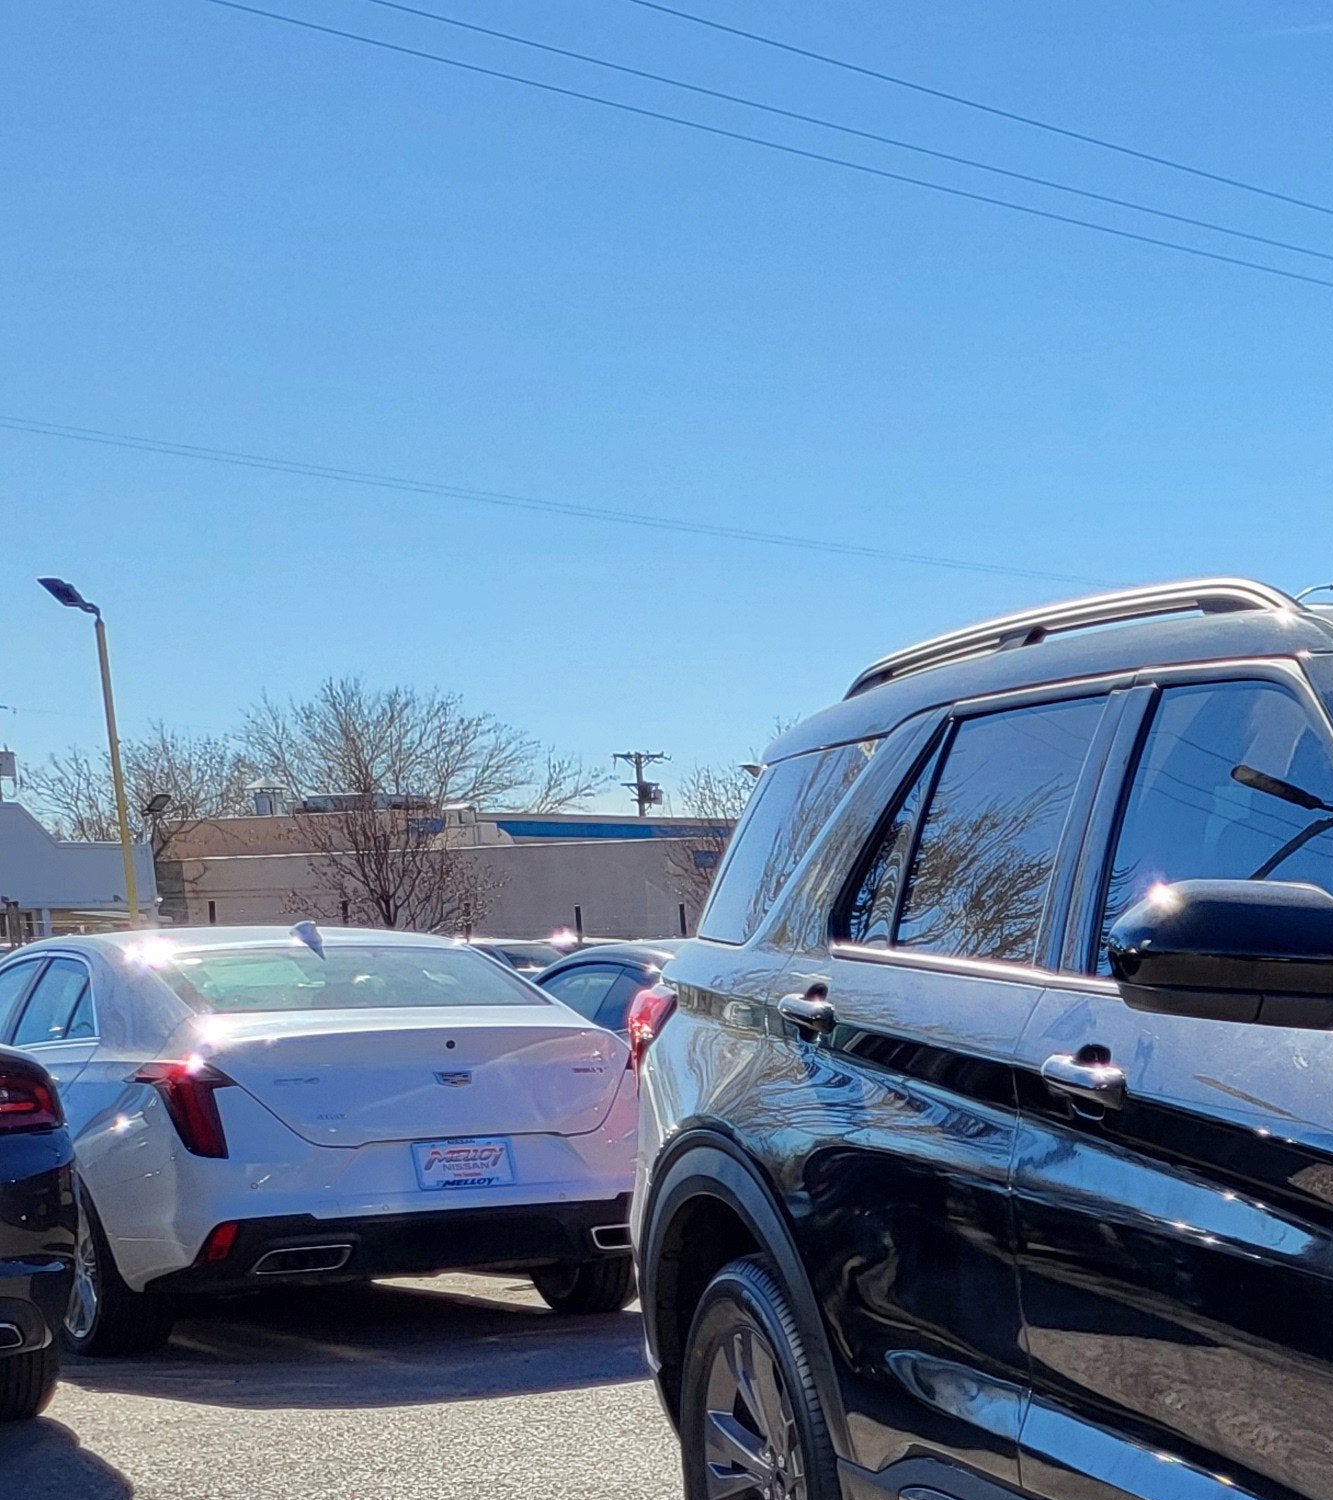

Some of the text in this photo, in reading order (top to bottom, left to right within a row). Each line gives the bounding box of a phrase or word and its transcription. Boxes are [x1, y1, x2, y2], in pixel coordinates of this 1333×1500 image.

[424, 1147, 504, 1171] MELLOY
[442, 1162, 490, 1172] NISSAN
[442, 1177, 494, 1188] MELLOY
